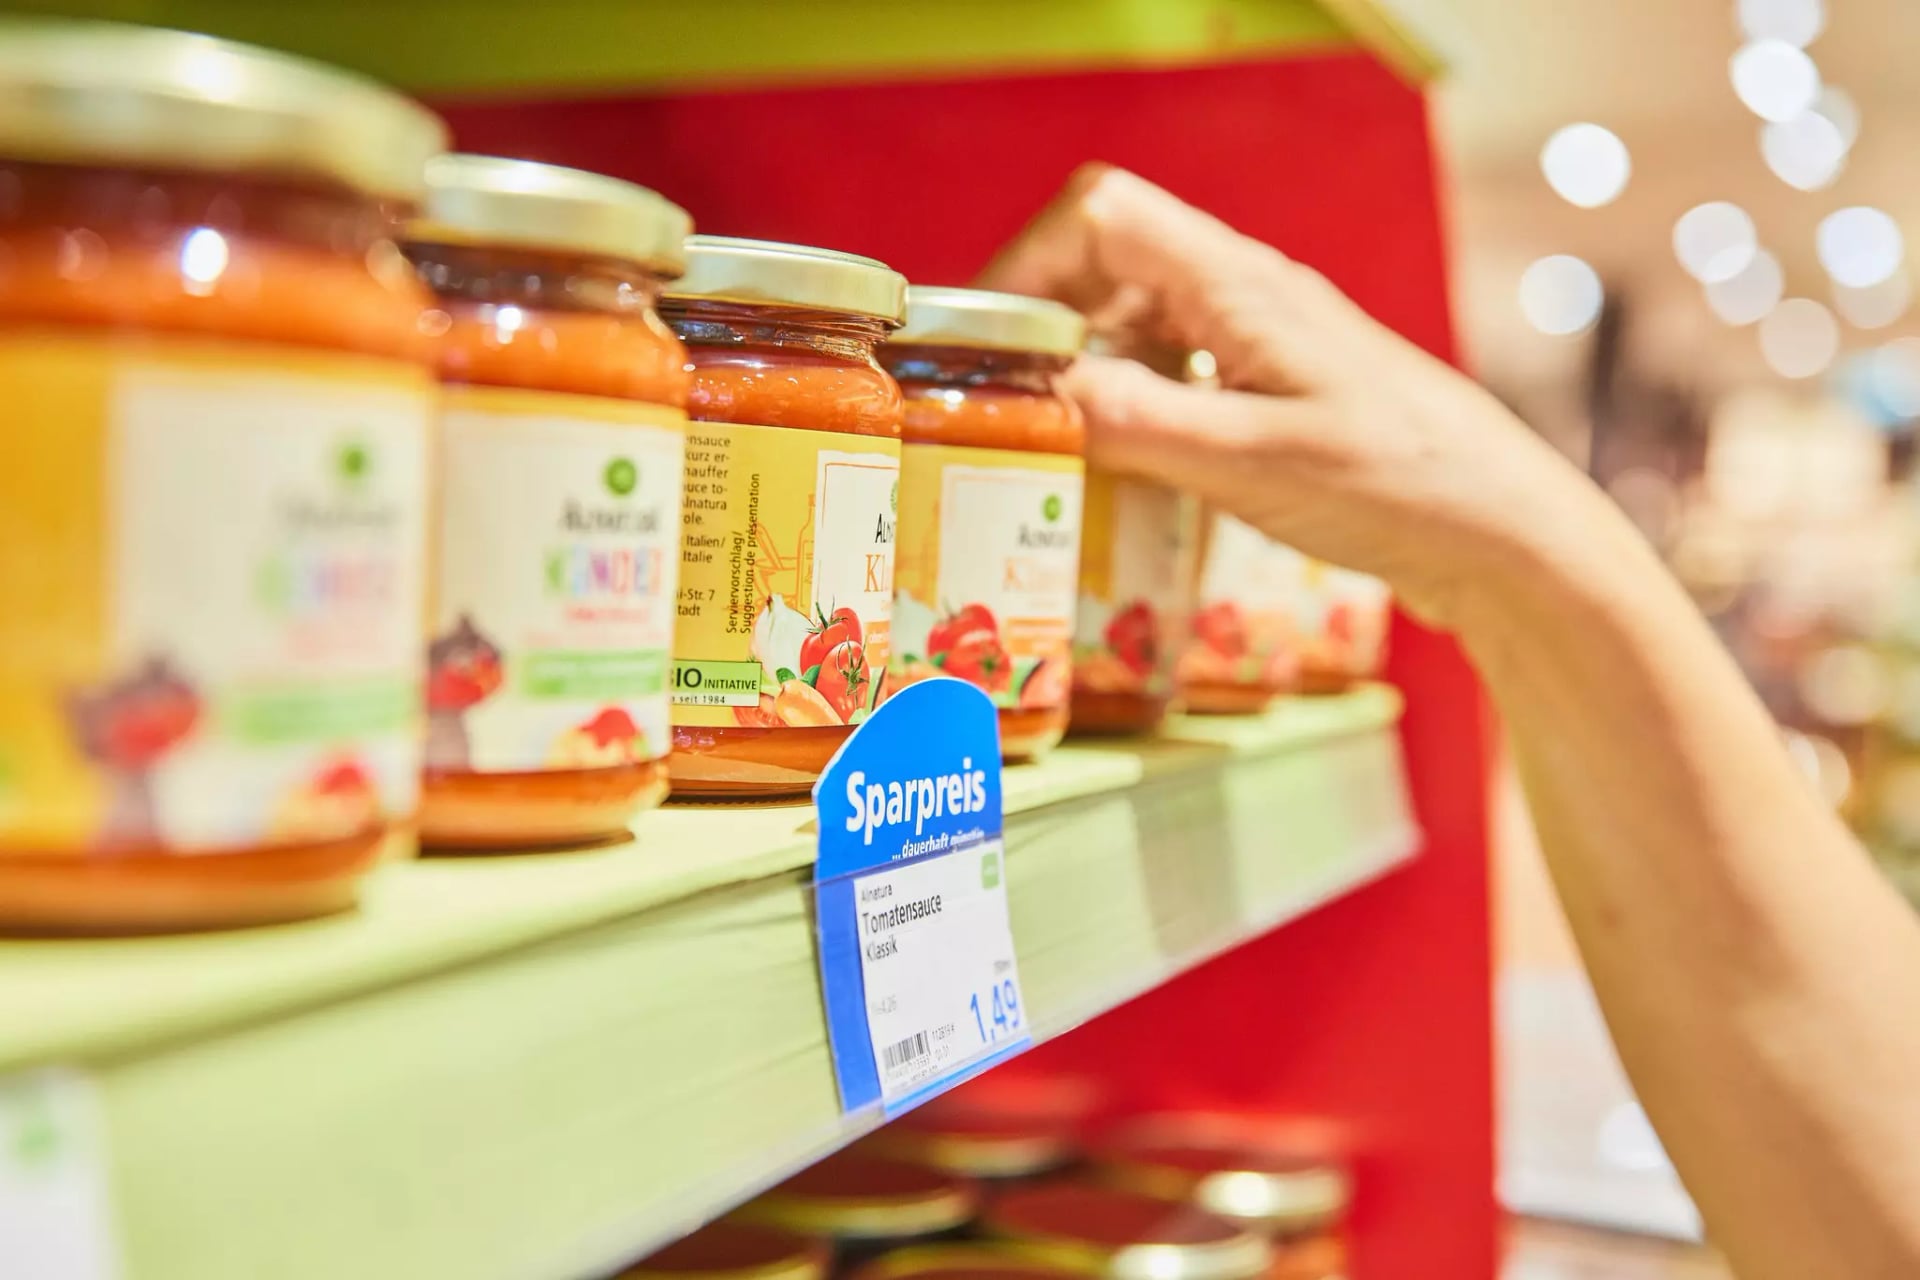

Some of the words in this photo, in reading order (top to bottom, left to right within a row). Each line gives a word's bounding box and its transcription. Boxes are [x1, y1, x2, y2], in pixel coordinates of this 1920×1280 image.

[714, 453, 730, 462] er-
[711, 483, 728, 494] to-
[746, 473, 760, 547] présentation
[686, 534, 726, 549] Italien/
[683, 550, 713, 563] Italie
[744, 551, 755, 565] de
[726, 530, 745, 633] Serviervorschlag/
[709, 589, 716, 601] 7
[740, 569, 754, 633] Suggestion
[671, 667, 703, 689] IO
[704, 678, 758, 690] INITIATIVE
[679, 695, 698, 703] seit
[703, 695, 726, 704] 1984
[845, 757, 986, 845] Sparpreis
[862, 894, 942, 936] Tomatensauce
[866, 934, 898, 962] Klassik
[970, 979, 1020, 1043] 1,49
